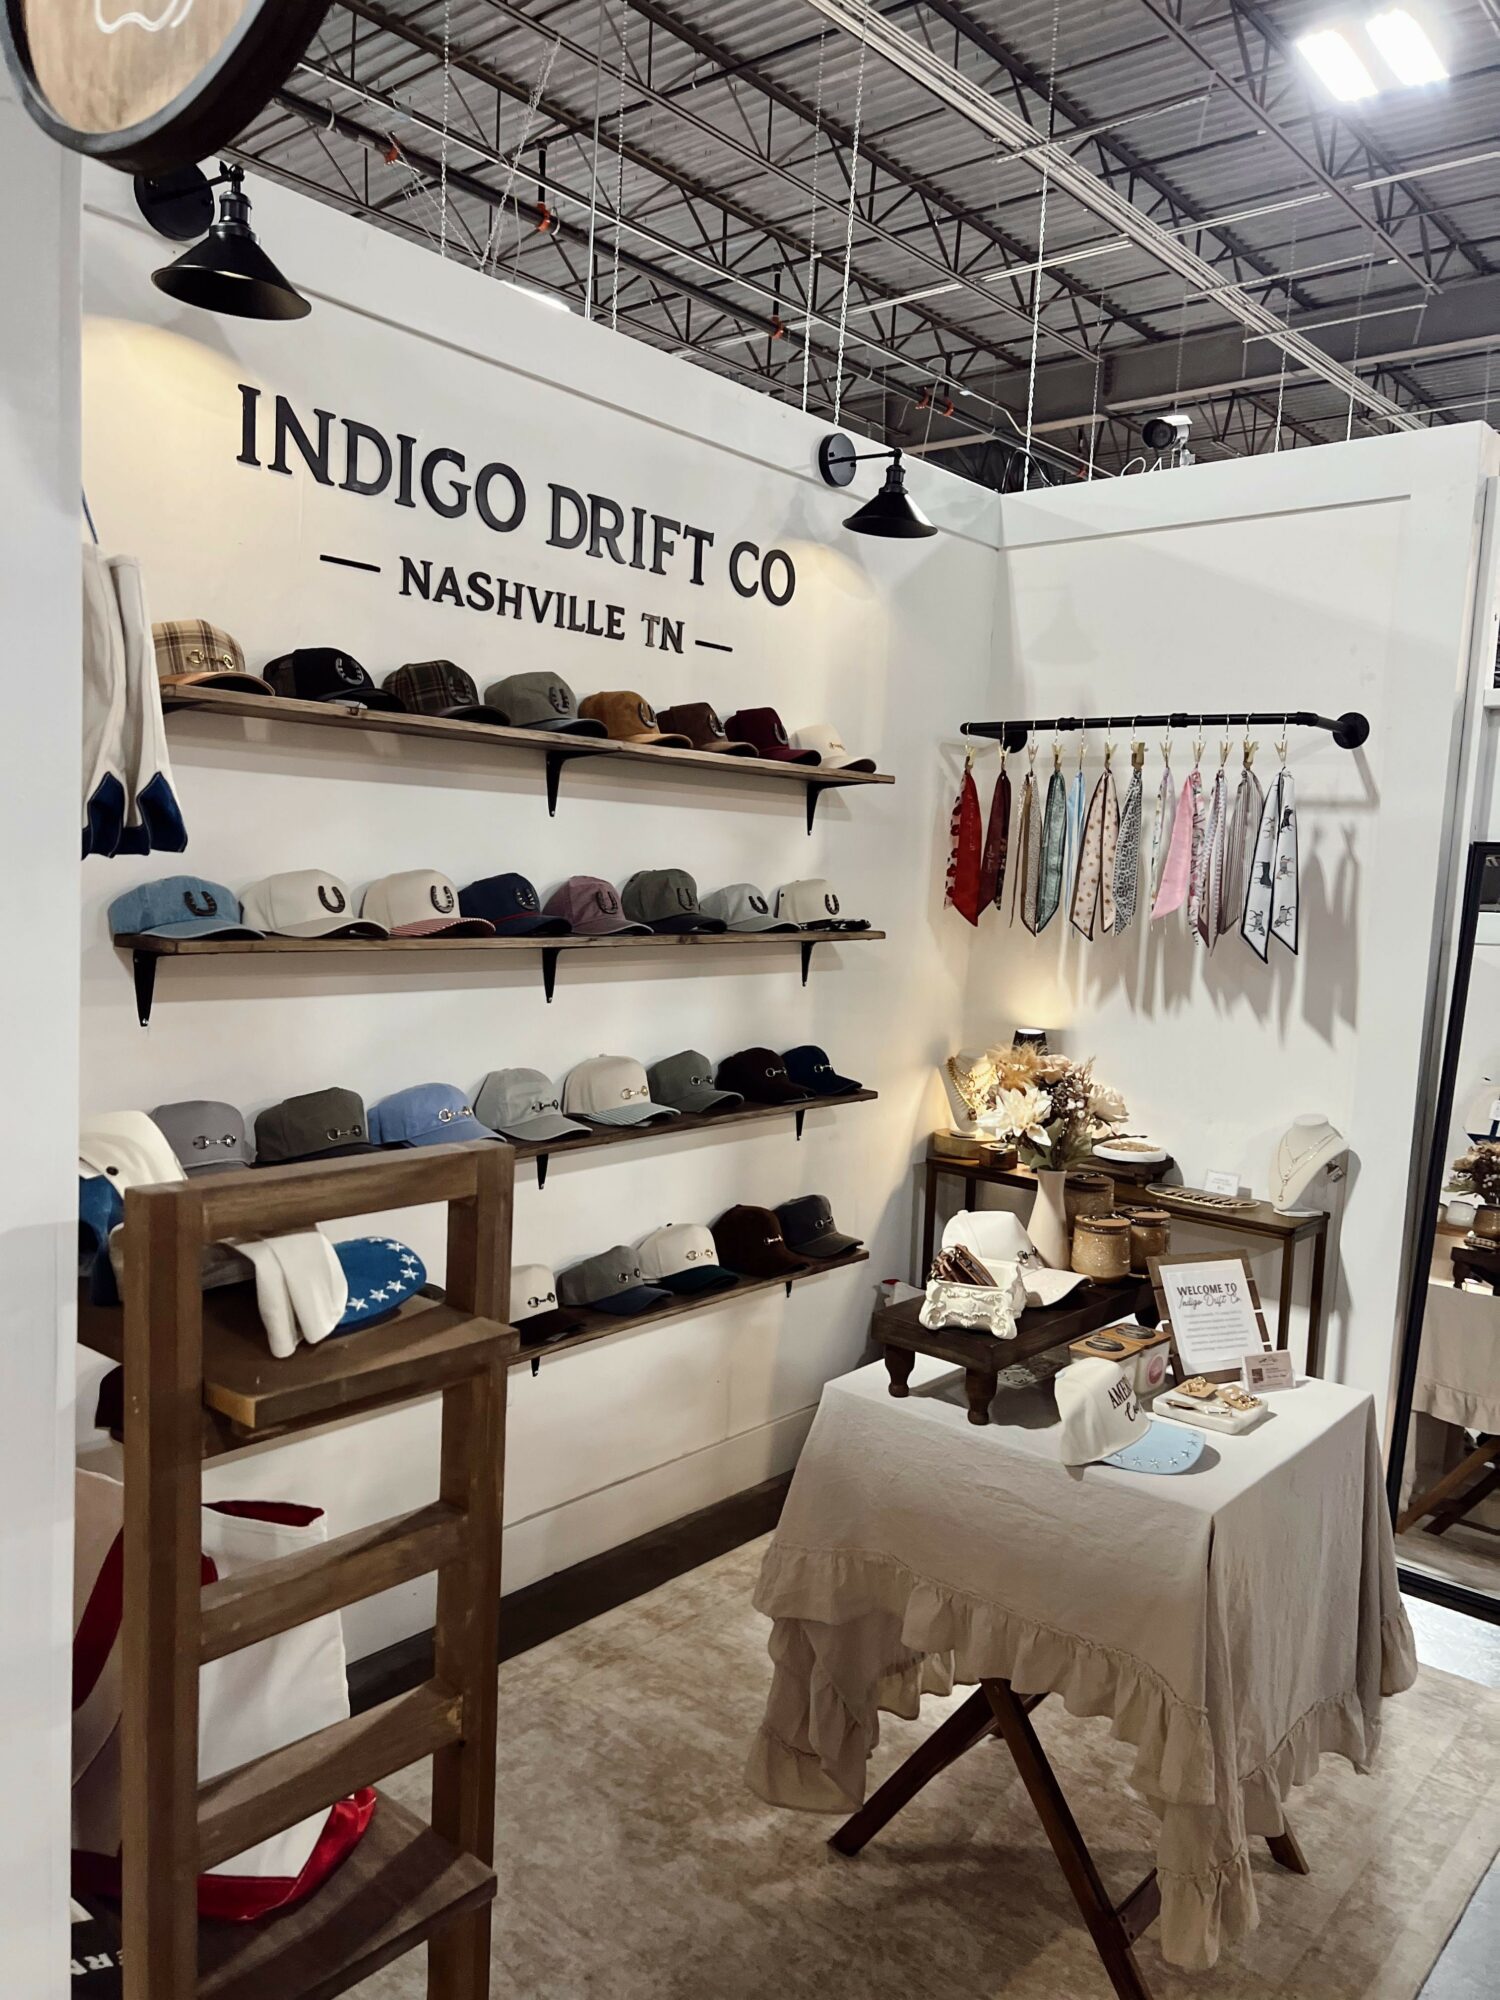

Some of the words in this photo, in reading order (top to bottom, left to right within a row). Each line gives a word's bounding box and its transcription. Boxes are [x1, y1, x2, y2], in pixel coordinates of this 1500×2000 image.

[236, 384, 526, 533] INDIGO
[546, 483, 715, 586] DRIFT
[729, 541, 796, 606] CO
[398, 556, 625, 641] NASHVILLE
[640, 612, 685, 654] TN
[1176, 1284, 1223, 1296] WELCOME
[1224, 1283, 1237, 1293] TO
[1178, 1295, 1203, 1310] Indigo
[1203, 1294, 1227, 1307] Drift
